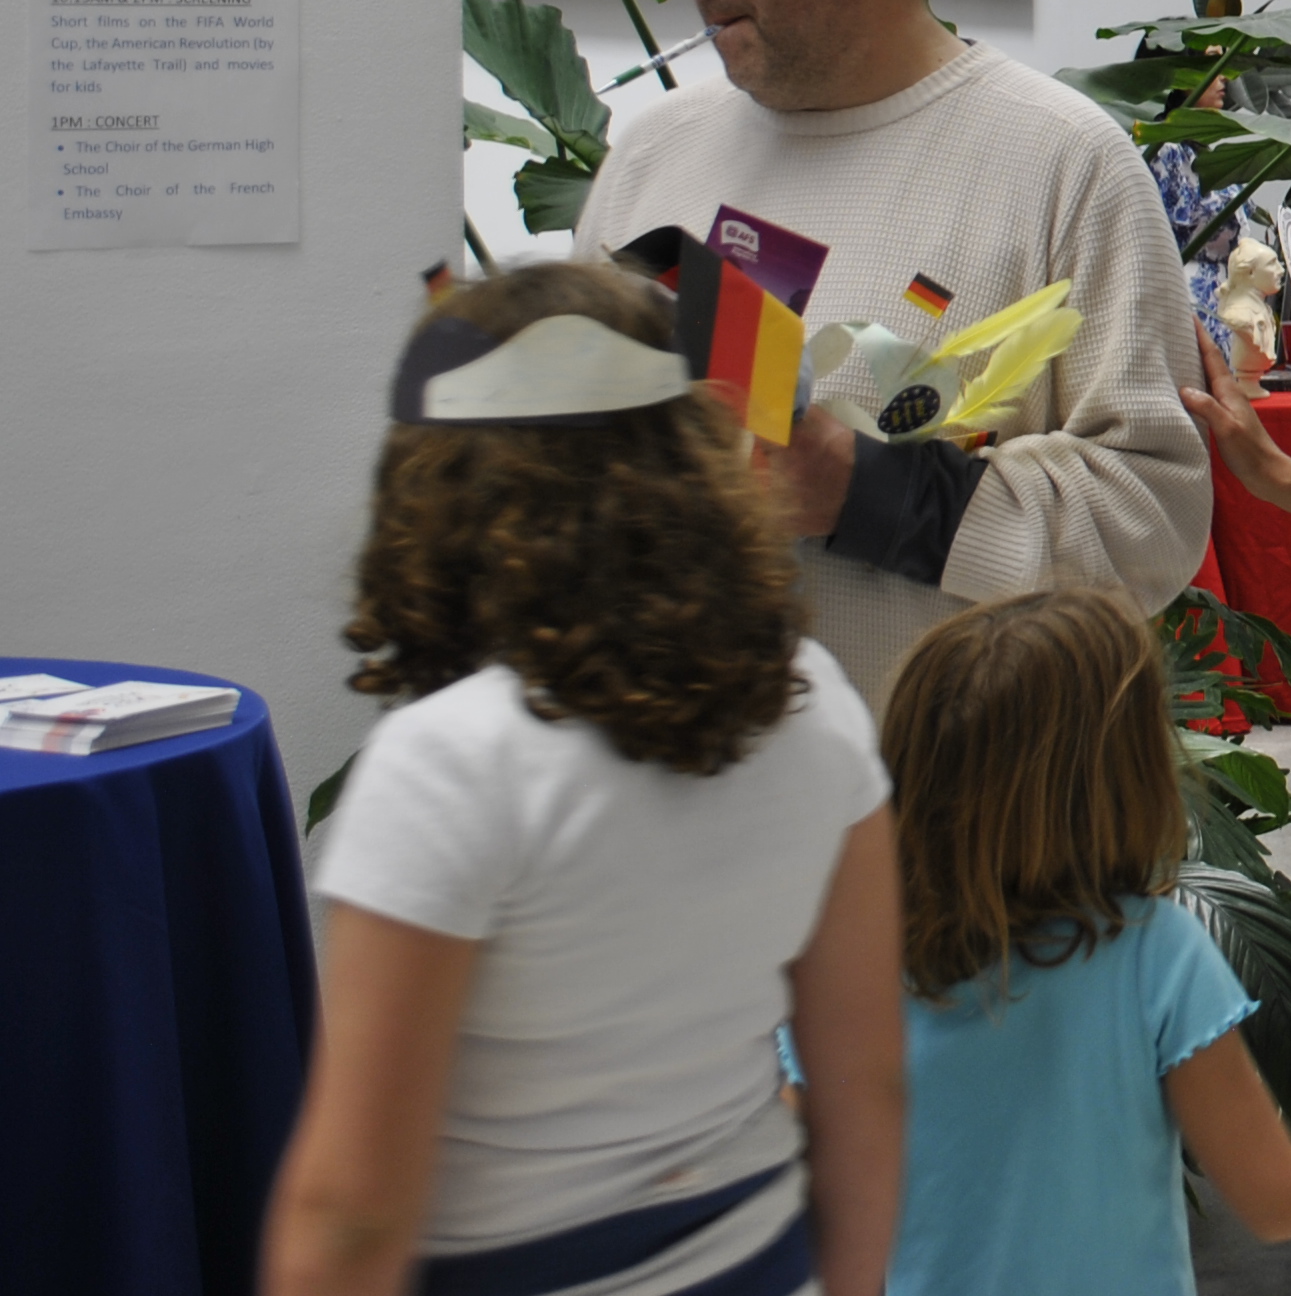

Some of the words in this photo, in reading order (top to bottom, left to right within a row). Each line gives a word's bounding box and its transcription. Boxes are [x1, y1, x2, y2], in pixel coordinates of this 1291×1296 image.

[51, 15, 88, 28] Short
[97, 15, 130, 28] films
[139, 18, 156, 28] on
[165, 15, 187, 28] the
[197, 16, 225, 28] FIFA
[233, 15, 274, 28] World
[51, 37, 82, 53] Cup,
[86, 37, 108, 49] the
[111, 37, 176, 50] American
[180, 37, 250, 50] Revolution
[253, 37, 274, 52] (by
[51, 59, 74, 71] the
[83, 59, 145, 73] Lafayette
[153, 58, 187, 72] Trail)
[195, 58, 219, 71] and
[228, 58, 274, 71] movies
[51, 80, 70, 93] for
[75, 80, 102, 93] kids
[51, 116, 83, 129] 1PM
[95, 115, 160, 129] CONCERT
[76, 141, 100, 153] The
[105, 140, 141, 153] Choir
[145, 140, 159, 153] of
[162, 140, 184, 152] the
[187, 140, 241, 152] German
[245, 139, 274, 153] High
[63, 163, 109, 176] School
[76, 185, 100, 197] The
[115, 184, 151, 197] Choir
[166, 184, 180, 196] of
[194, 183, 216, 195] the
[230, 182, 274, 194] French
[63, 207, 123, 221] Embassy
